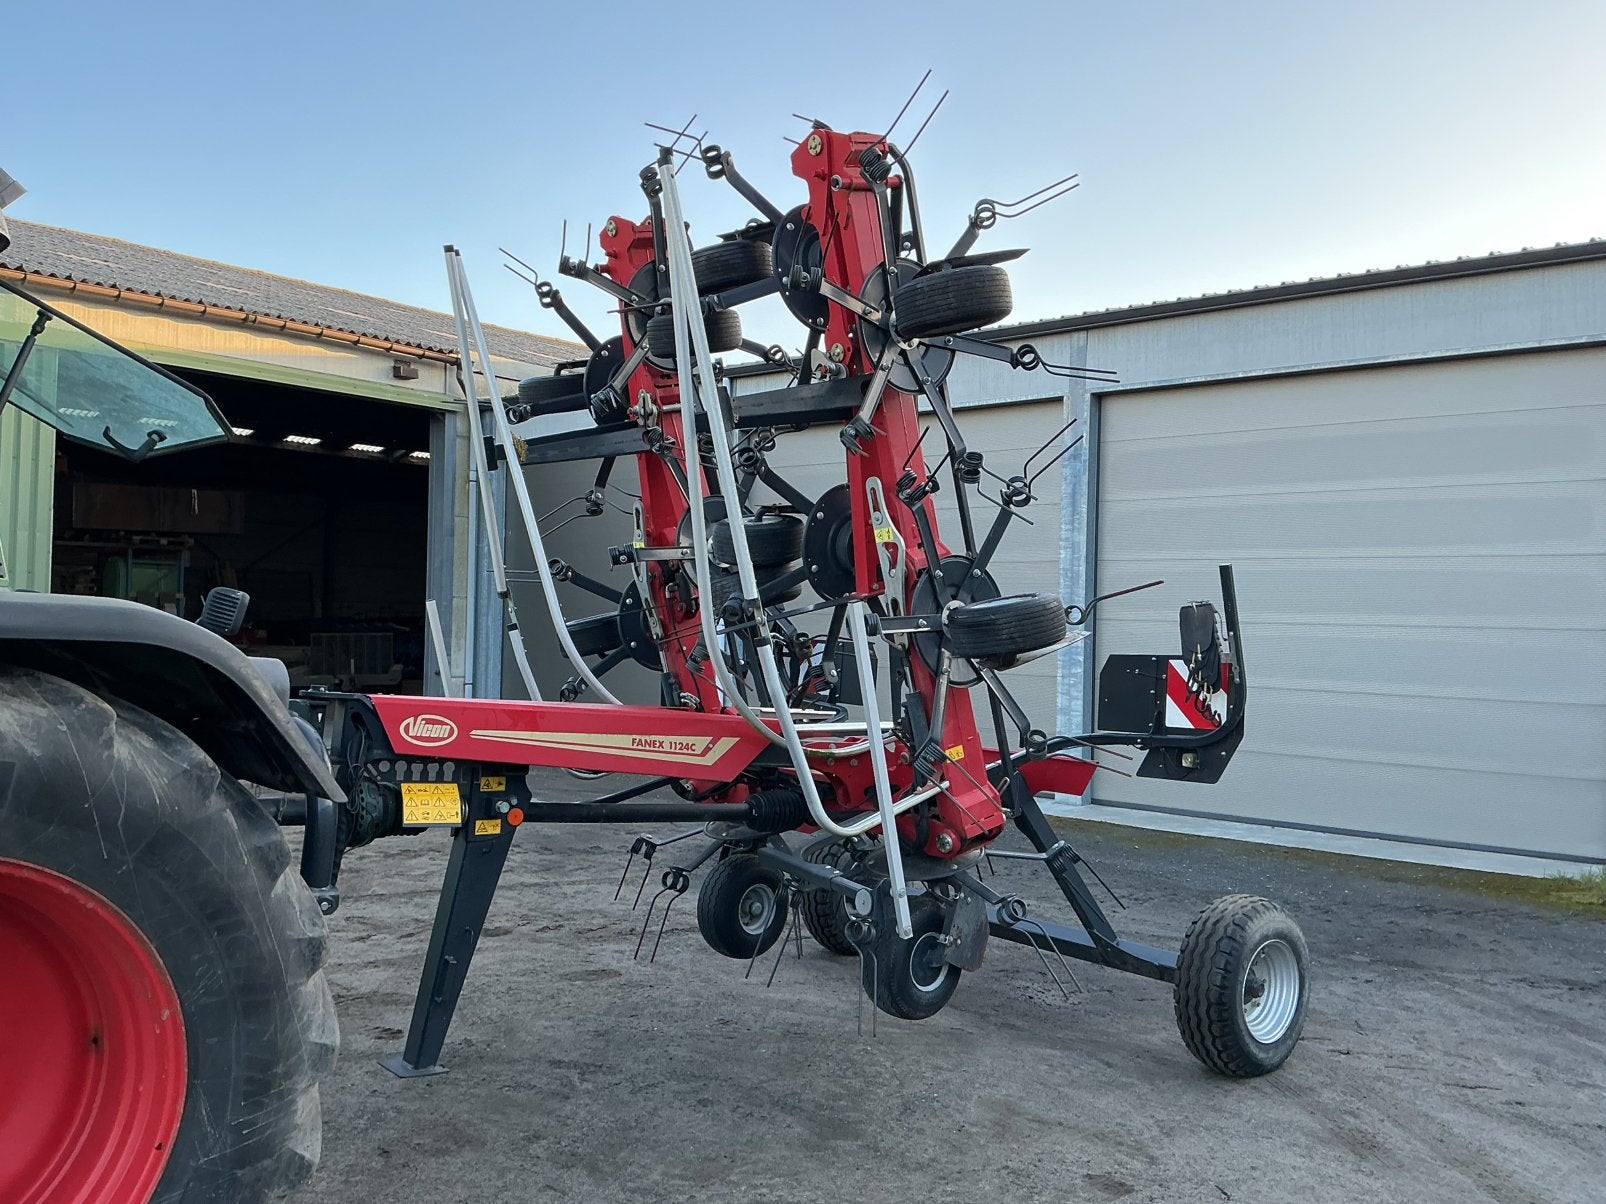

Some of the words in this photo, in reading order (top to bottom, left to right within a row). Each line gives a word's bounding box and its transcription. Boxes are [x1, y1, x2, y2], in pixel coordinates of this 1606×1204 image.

[407, 714, 452, 738] Vicon
[631, 737, 665, 750] FANEX
[668, 741, 697, 752] 1124C
